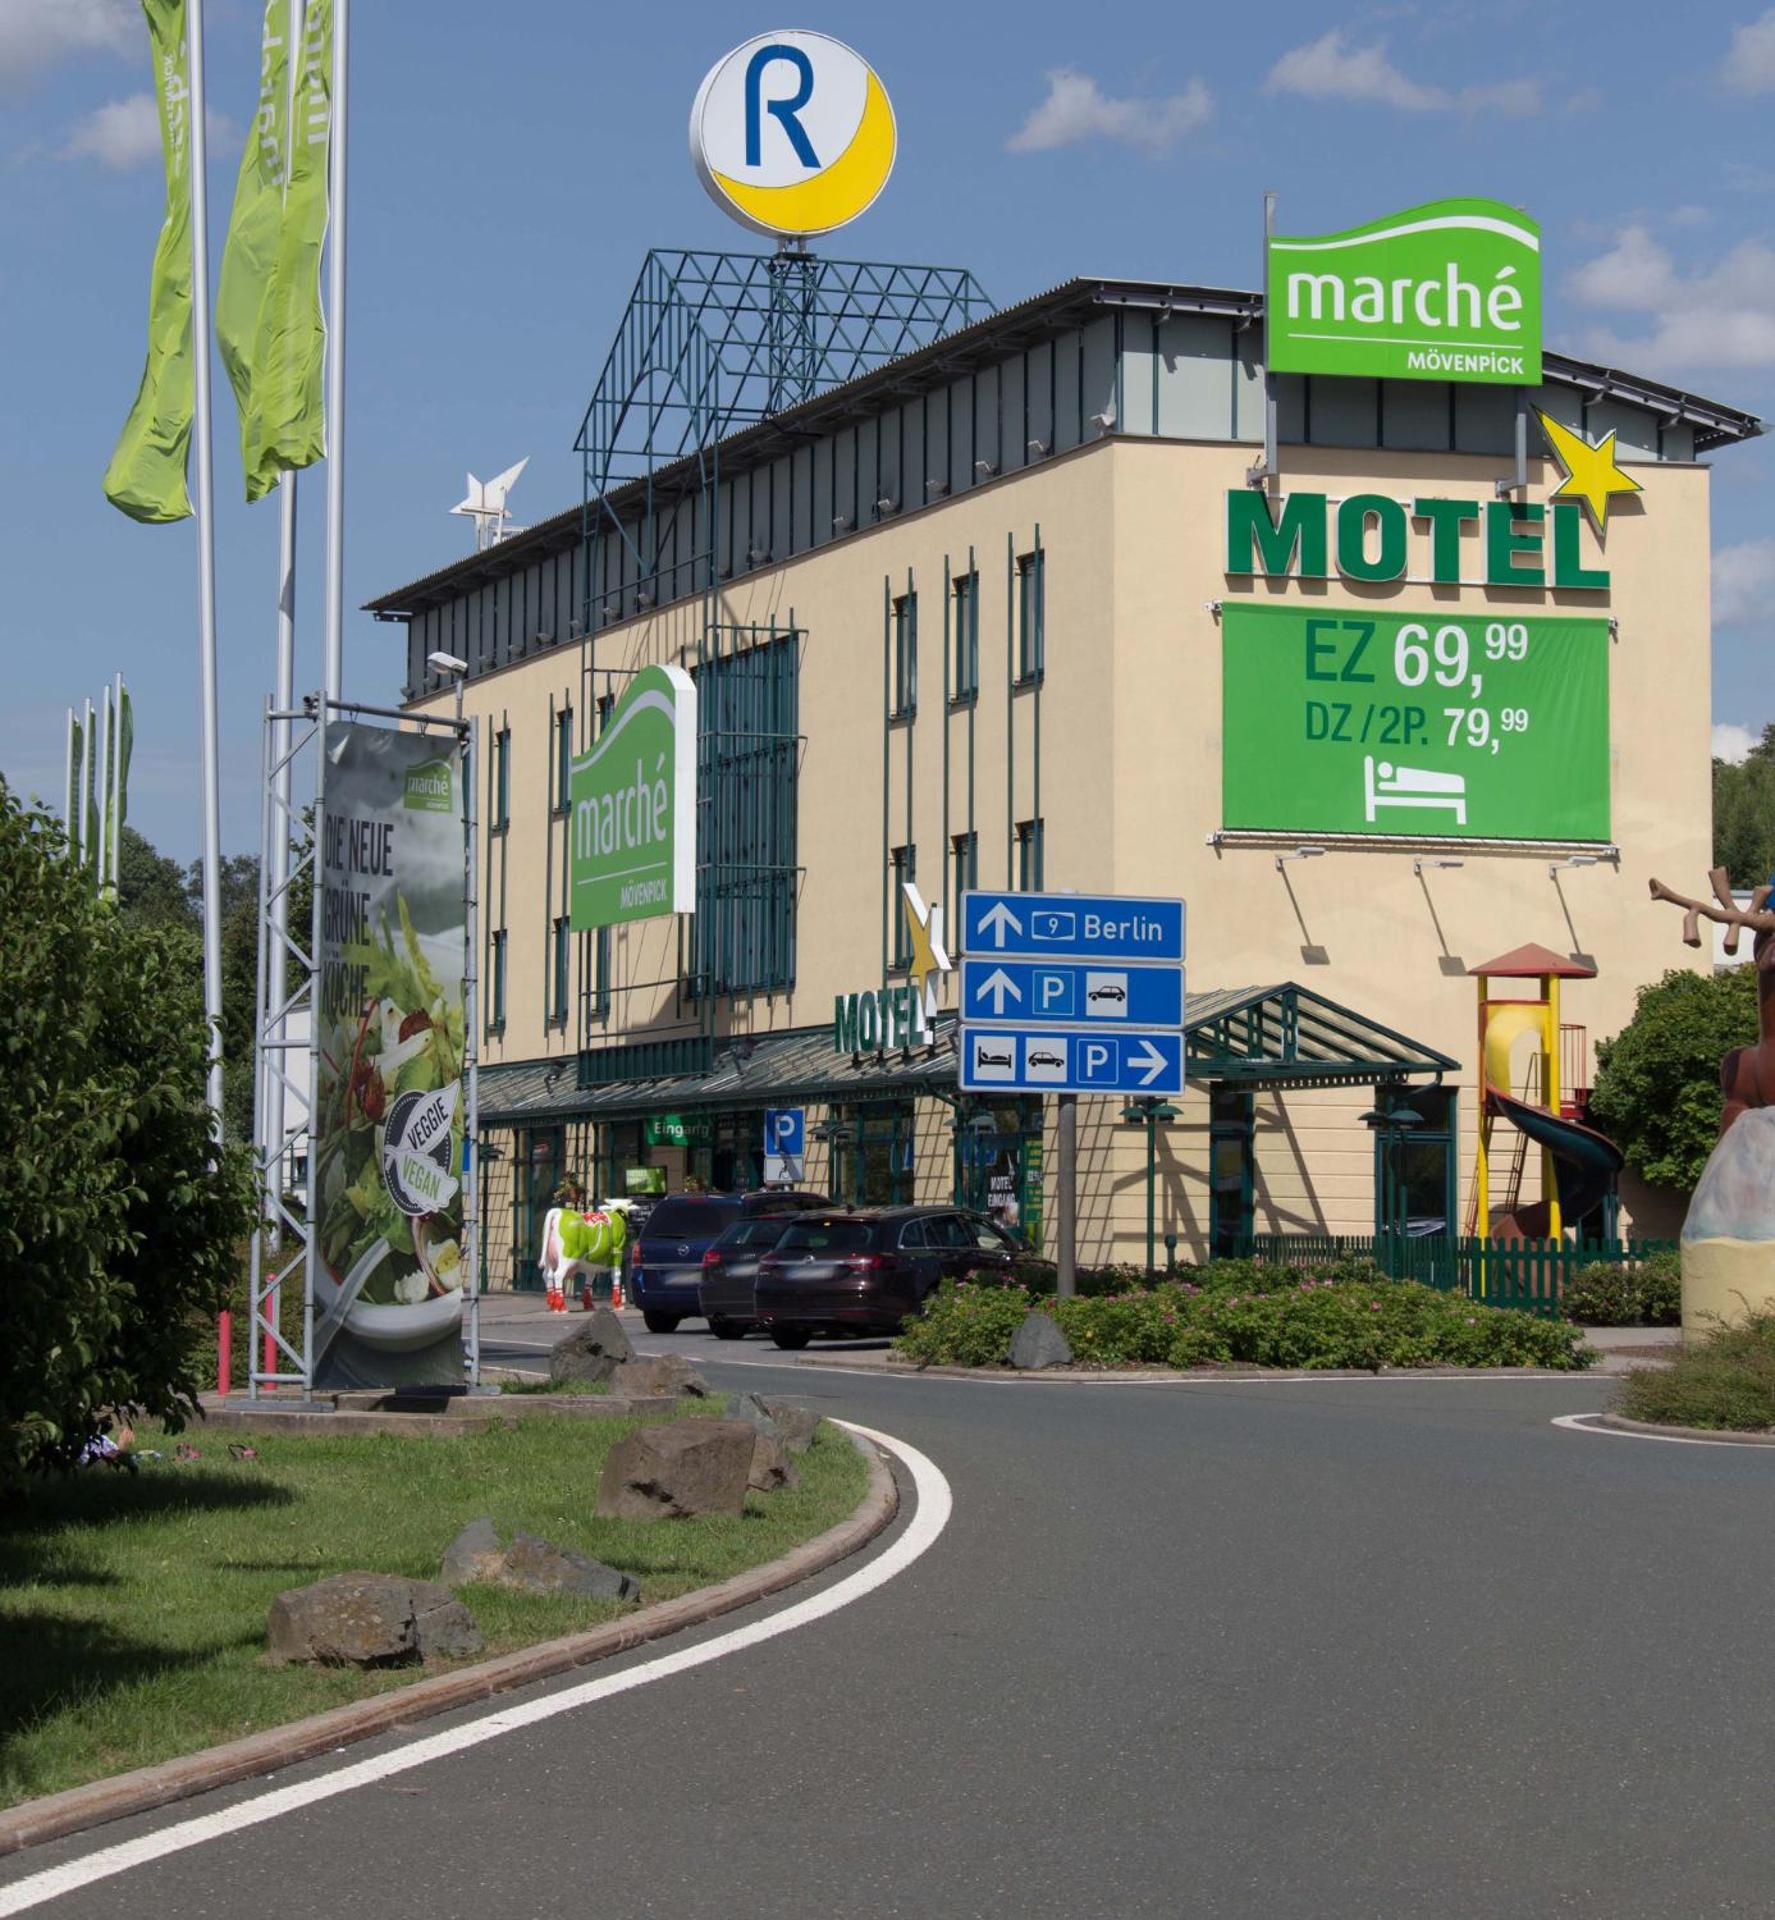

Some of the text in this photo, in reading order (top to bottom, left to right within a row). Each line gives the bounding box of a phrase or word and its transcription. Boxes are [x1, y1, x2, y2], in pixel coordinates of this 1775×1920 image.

[745, 44, 821, 168] R
[1288, 262, 1523, 331] marché
[1226, 488, 1611, 589] MOTEL
[1305, 618, 1376, 684] EZ
[408, 774, 449, 796] marché
[577, 752, 668, 861] marché
[324, 814, 394, 877] DIE NEUE
[323, 879, 371, 947] GRÜNE
[1048, 915, 1164, 942] 9 Berlin
[322, 950, 371, 1019] KÜCHE
[1043, 976, 1065, 1009] P
[835, 986, 930, 1053] MOTEL
[1087, 1045, 1108, 1078] P
[407, 1096, 449, 1150] VEGGIE
[654, 1120, 710, 1138] Eingang
[774, 1115, 796, 1150] P
[402, 1154, 441, 1201] VEGAN
